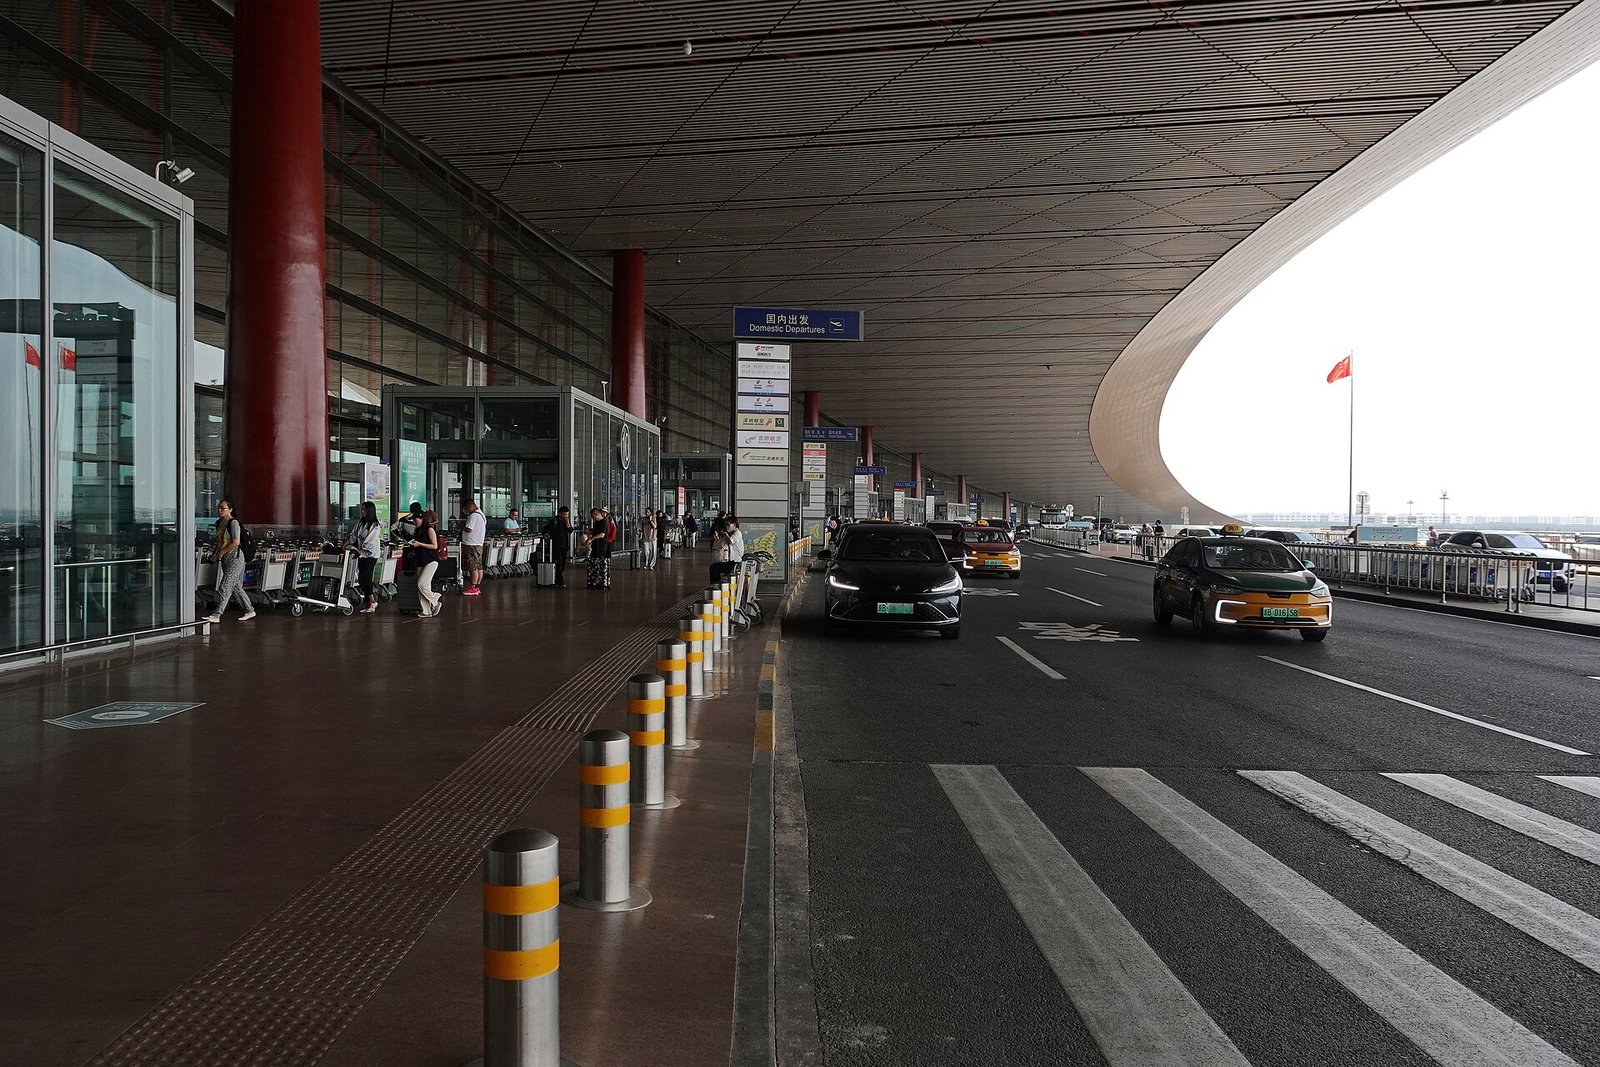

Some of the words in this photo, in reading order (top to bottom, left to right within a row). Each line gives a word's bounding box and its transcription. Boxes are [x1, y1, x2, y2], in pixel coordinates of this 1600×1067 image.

[766, 313, 809, 325] 国内出发
[749, 323, 784, 332] Domestic
[785, 325, 826, 334] Departures
